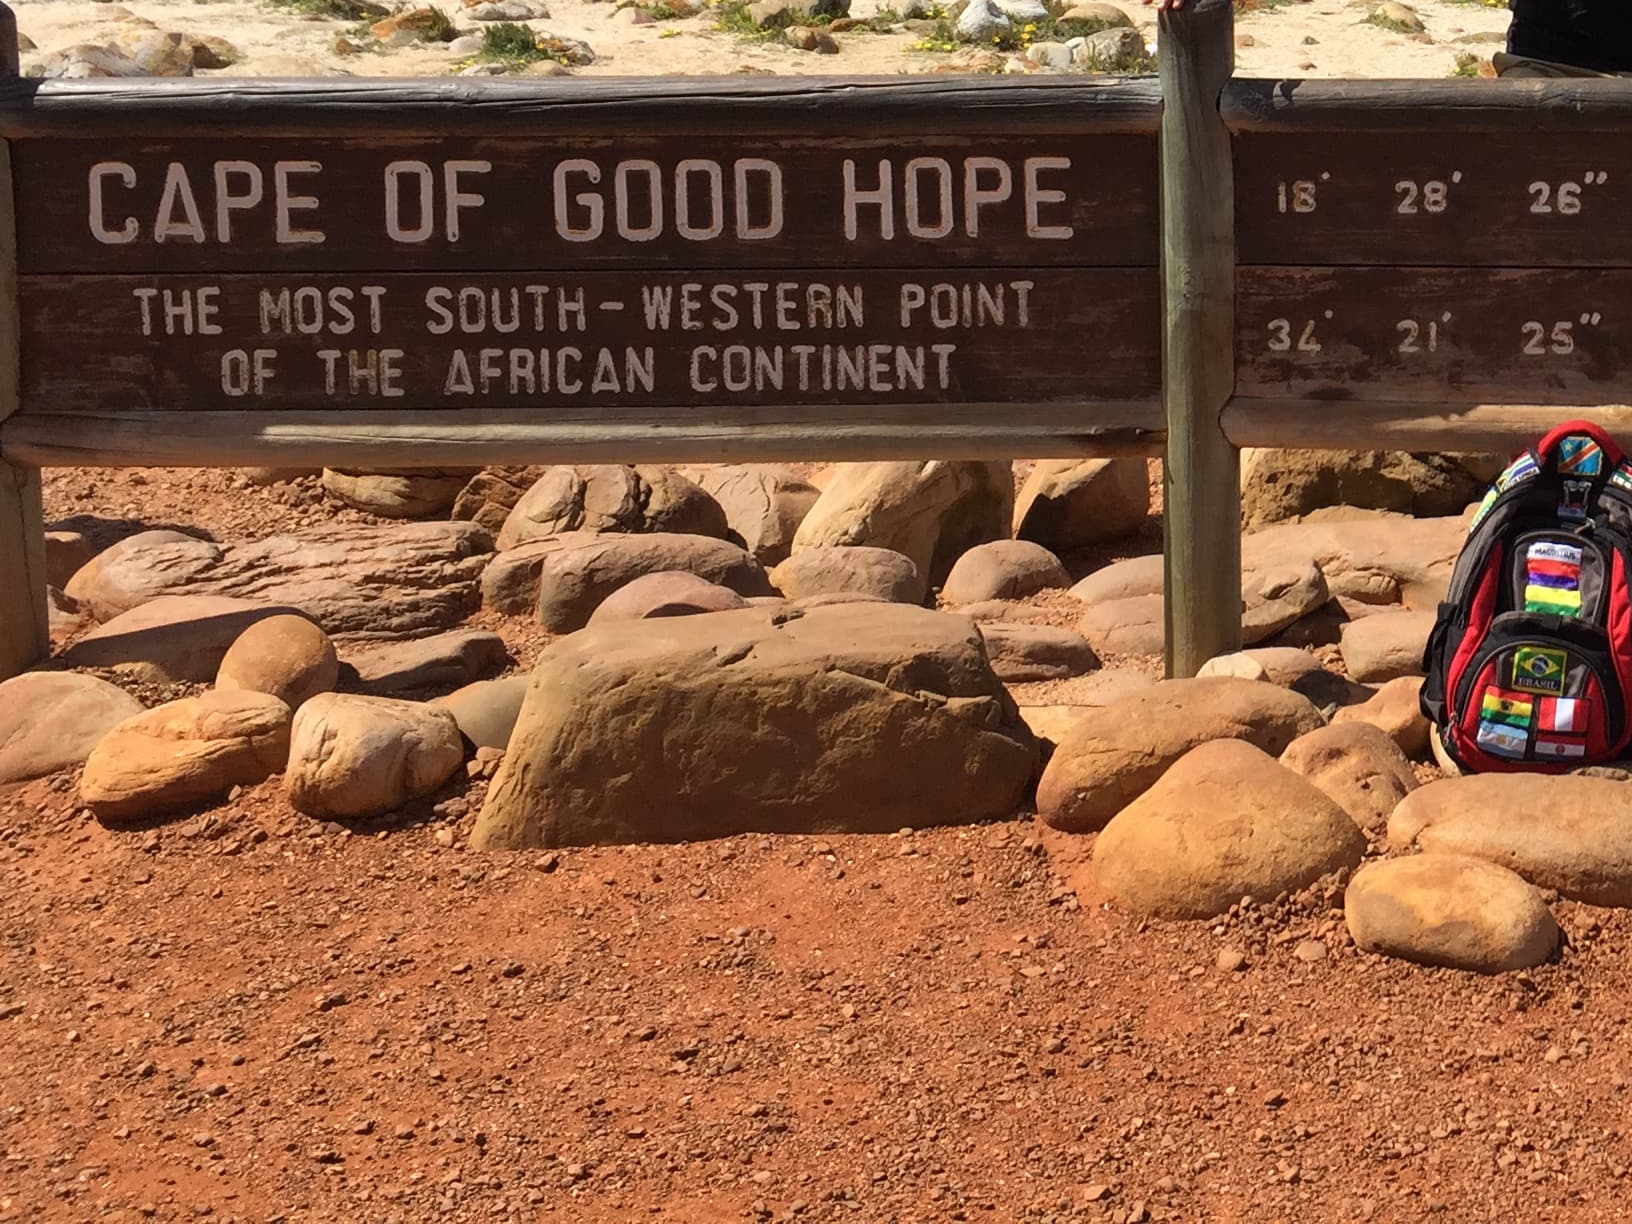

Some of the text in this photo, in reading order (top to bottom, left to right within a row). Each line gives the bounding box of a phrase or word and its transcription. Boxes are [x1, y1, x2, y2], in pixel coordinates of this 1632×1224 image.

[88, 156, 1074, 244] CAPE OF GOOD HOPE
[132, 286, 224, 336] THE
[258, 285, 387, 335] MOST
[899, 280, 1035, 329] POINT
[220, 343, 957, 397] OF THE AFRICAN CONTINENT
